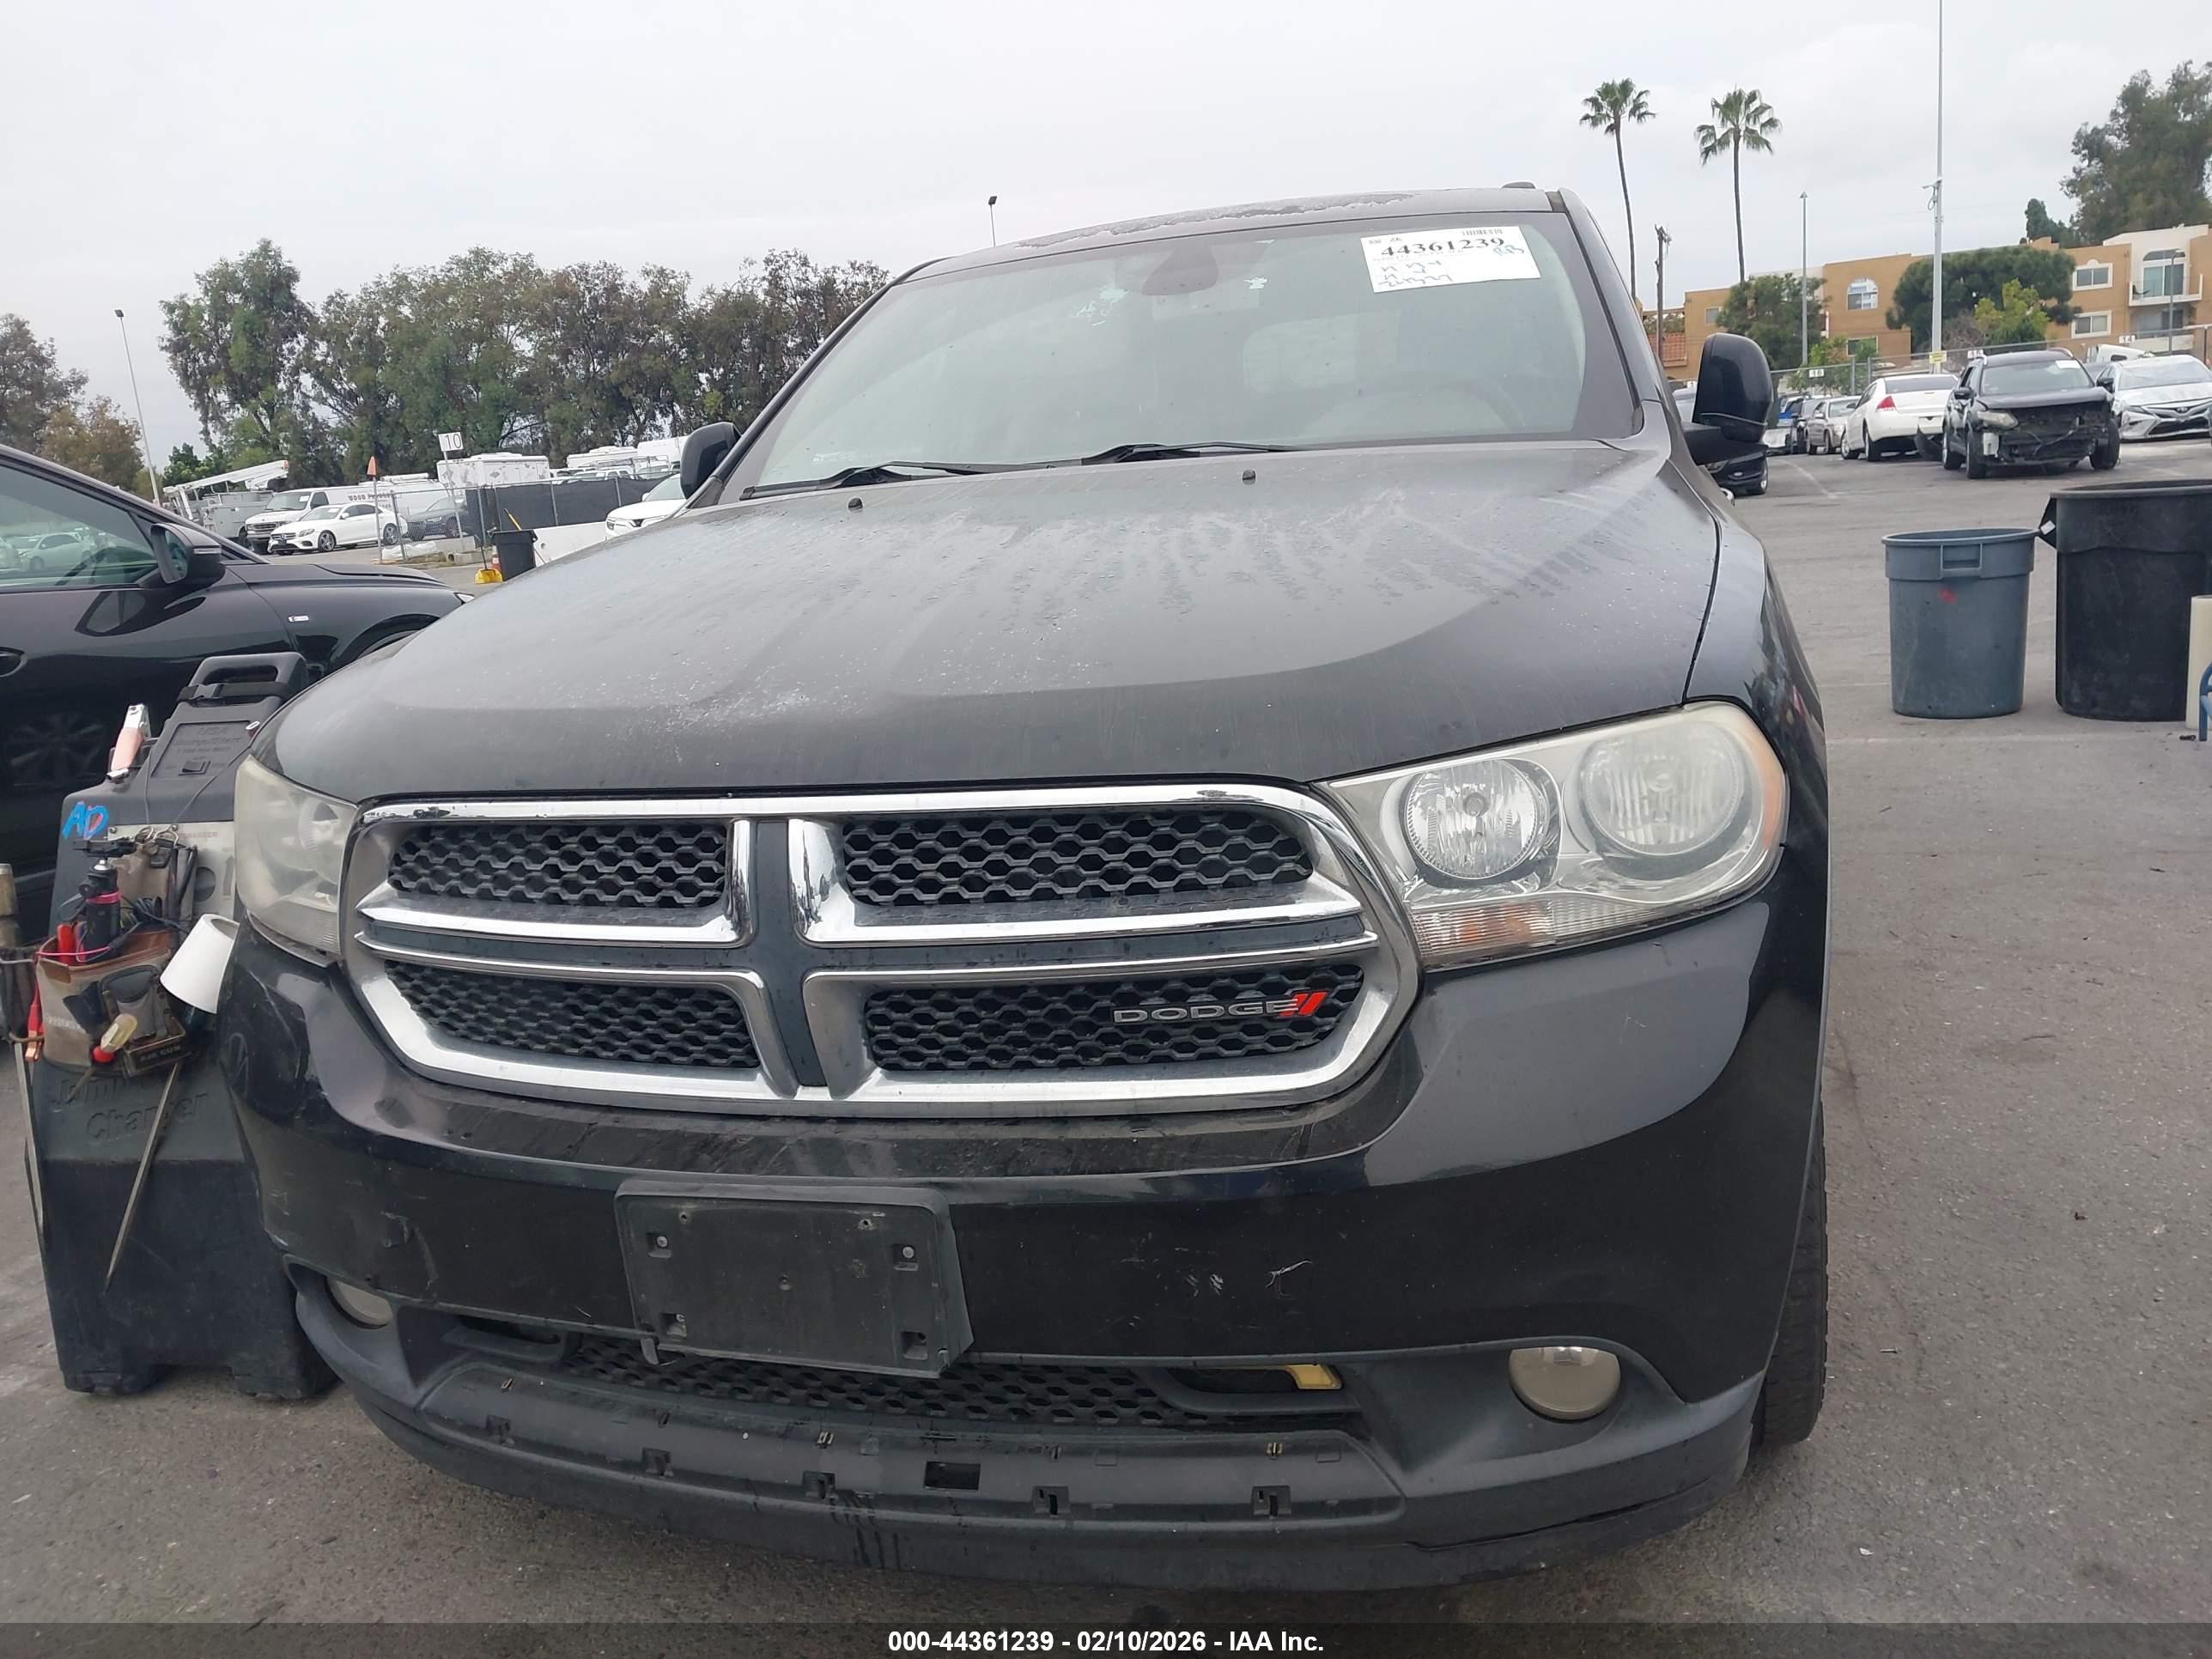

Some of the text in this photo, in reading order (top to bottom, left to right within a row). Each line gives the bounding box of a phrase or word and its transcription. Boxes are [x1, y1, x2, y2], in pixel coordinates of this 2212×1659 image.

[1381, 237, 1504, 257] 44361239
[445, 433, 462, 449] 10
[63, 802, 109, 839] AD
[1114, 998, 1299, 1023] DODGE
